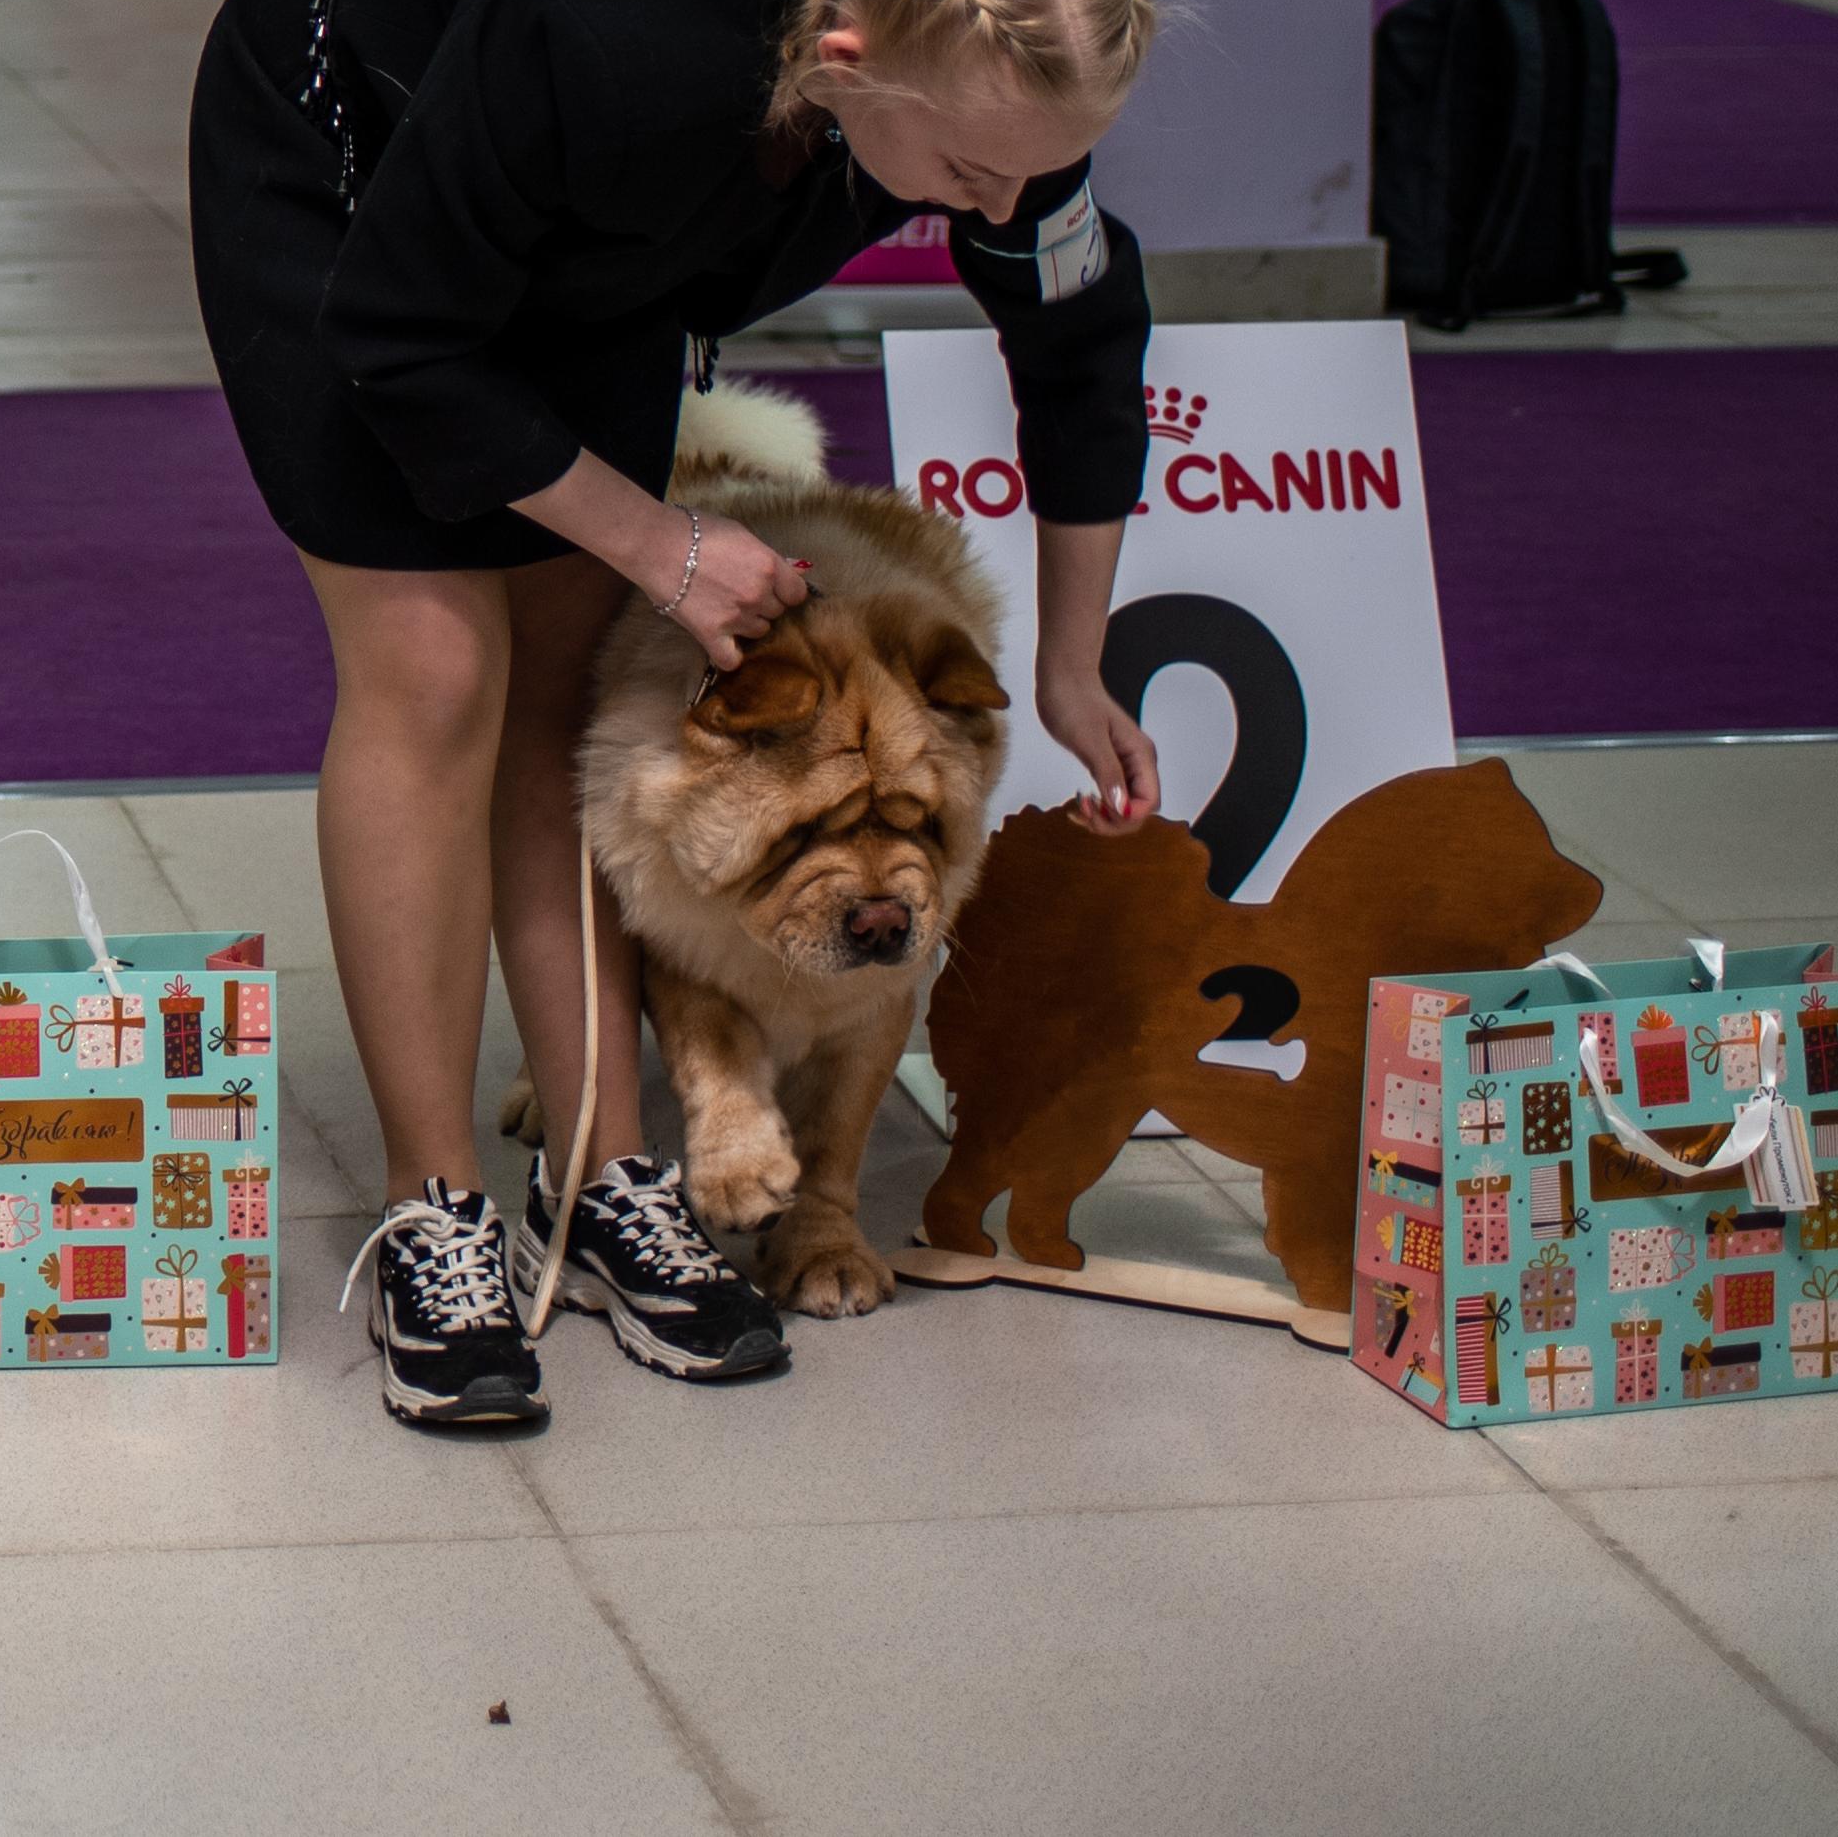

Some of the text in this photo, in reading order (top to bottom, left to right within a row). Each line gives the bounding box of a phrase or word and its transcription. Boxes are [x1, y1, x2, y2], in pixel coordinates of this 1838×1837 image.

[1165, 448, 1400, 513] CANIN
[1197, 965, 1308, 1082] 2
[1772, 1141, 1791, 1196] Промежуток
